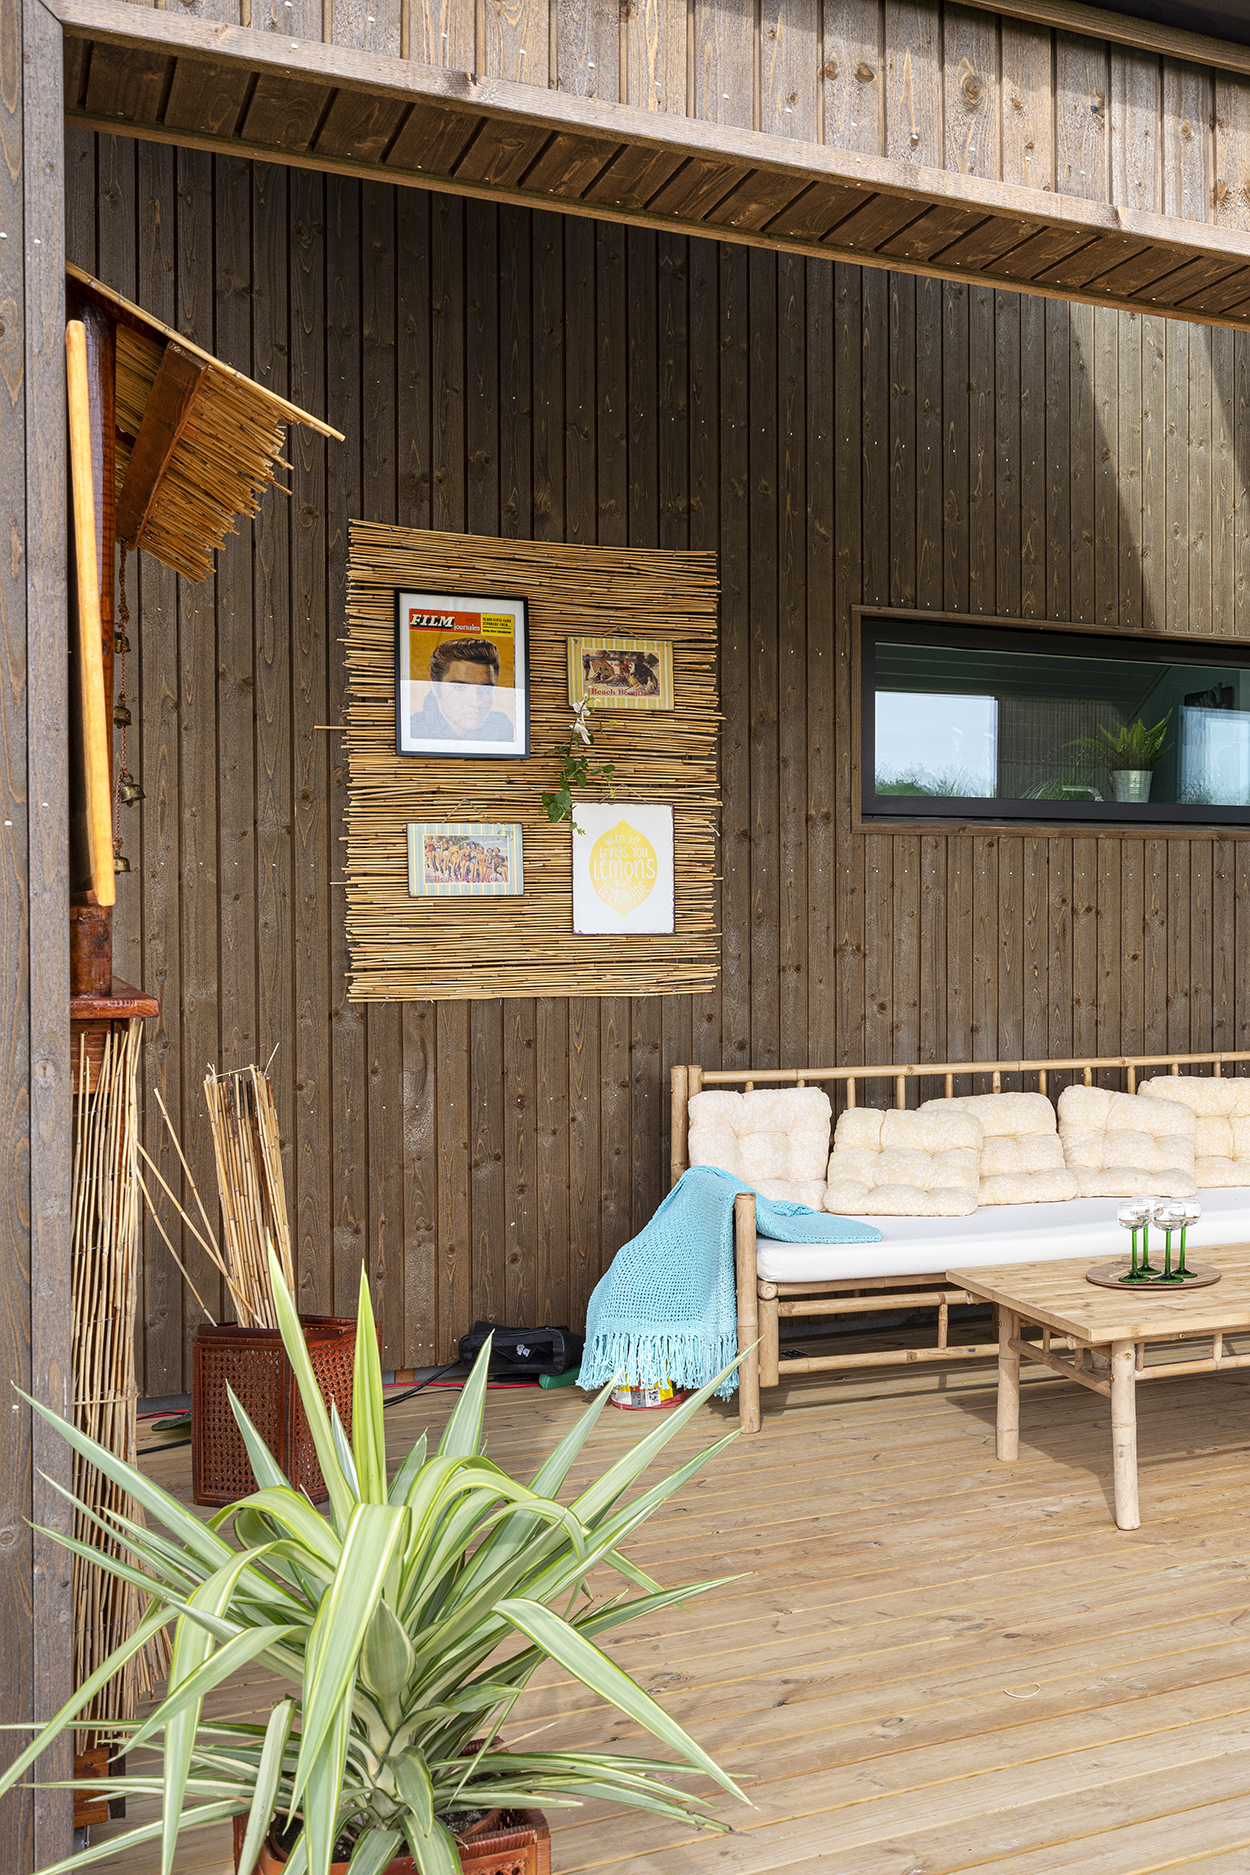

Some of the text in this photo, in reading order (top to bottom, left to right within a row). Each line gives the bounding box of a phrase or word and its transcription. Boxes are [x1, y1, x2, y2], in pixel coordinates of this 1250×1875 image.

[409, 613, 455, 628] FILM
[453, 623, 481, 631] journalen
[600, 846, 628, 859] brings
[598, 881, 651, 903] LEMONADE
